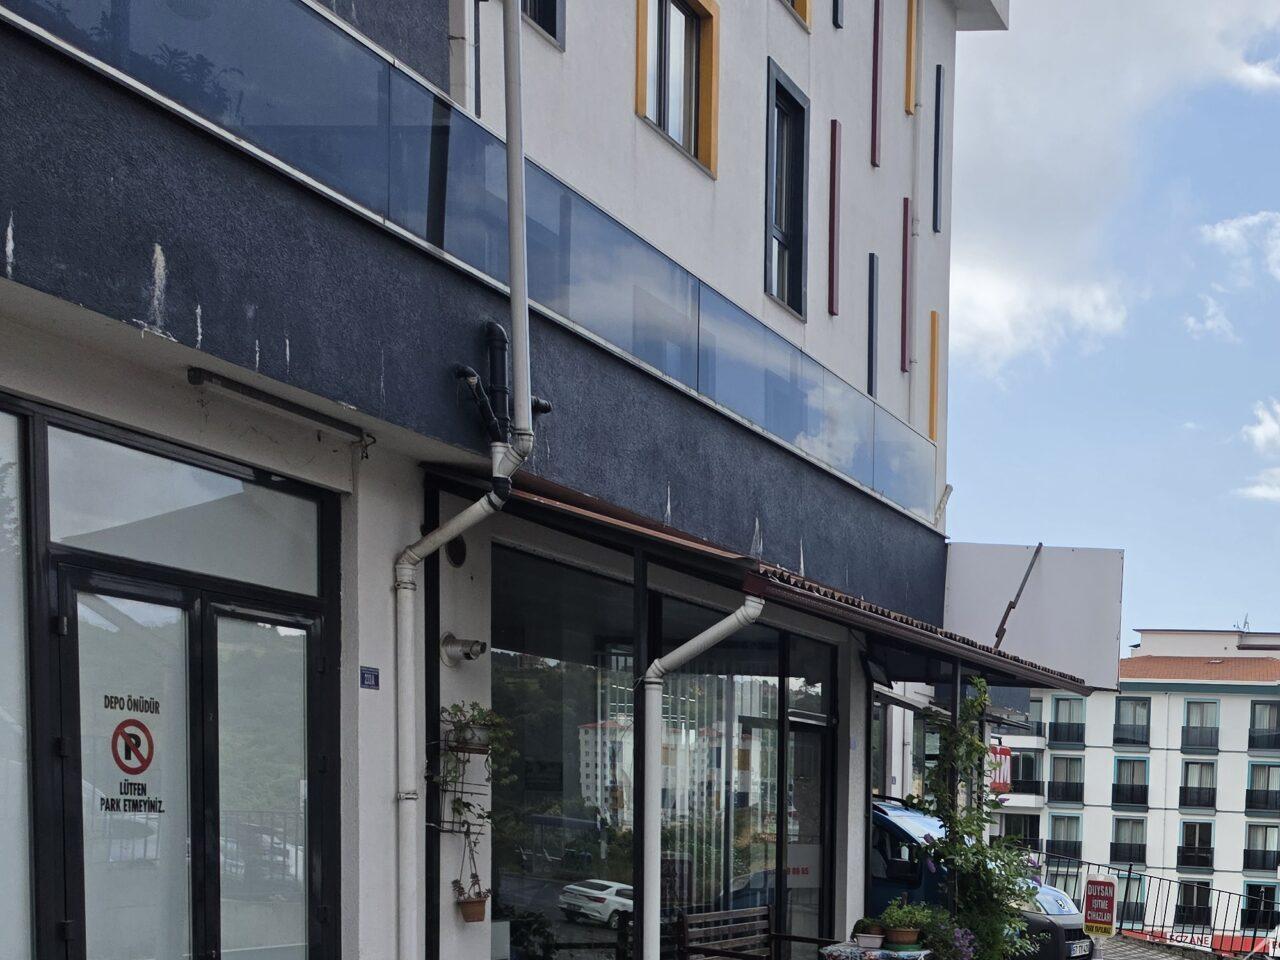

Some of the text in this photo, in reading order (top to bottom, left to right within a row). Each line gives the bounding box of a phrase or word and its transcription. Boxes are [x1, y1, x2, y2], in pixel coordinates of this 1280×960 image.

[104, 695, 160, 714] DEPO ÖNÜDÜR
[120, 779, 147, 797] LÜTFEN
[100, 798, 121, 812] PARK
[1088, 884, 1113, 897] DUYSAN
[1169, 934, 1210, 946] ECZANE
